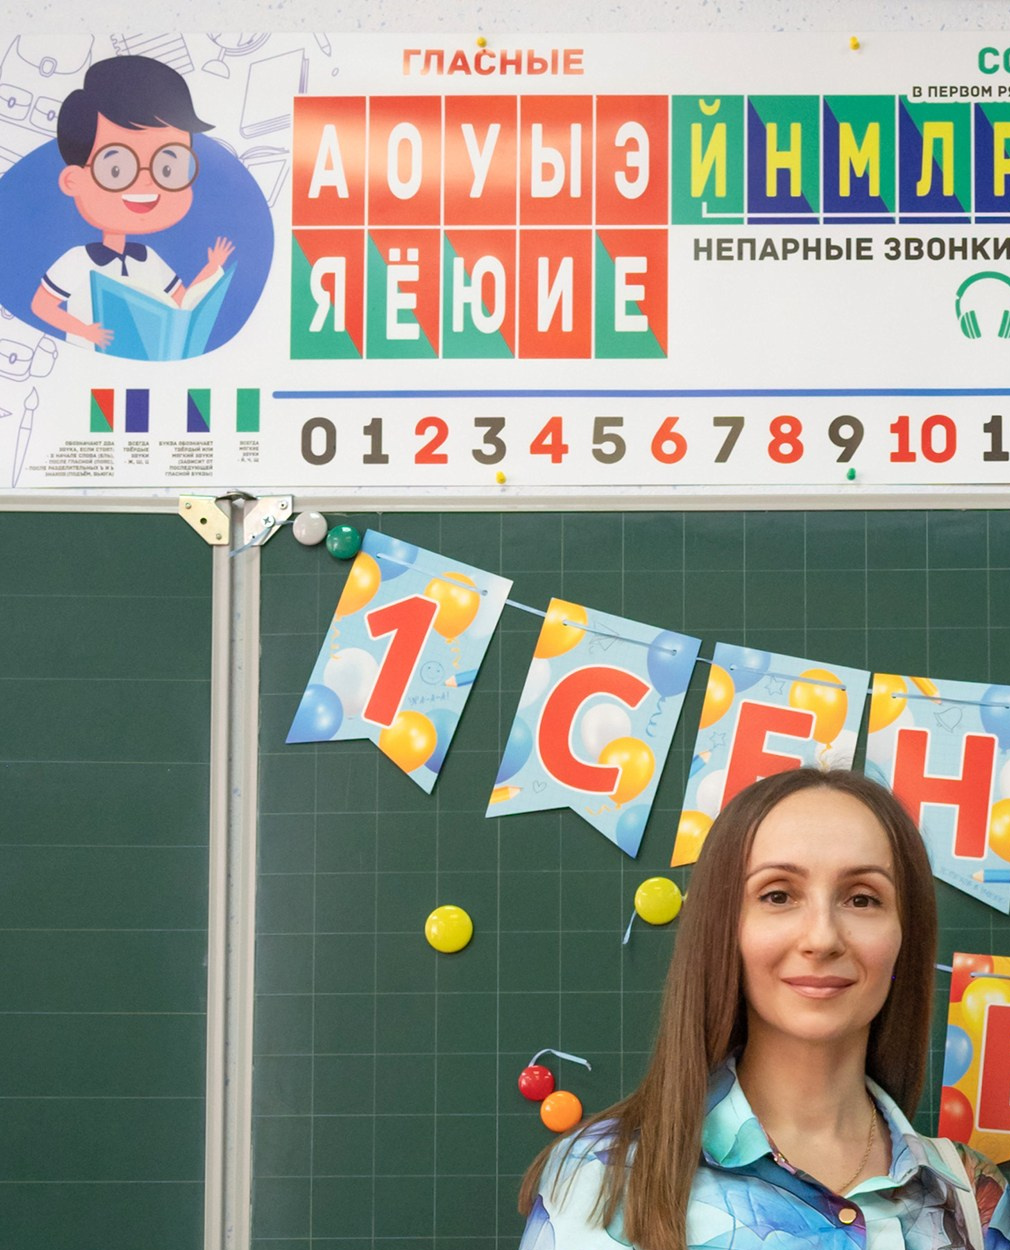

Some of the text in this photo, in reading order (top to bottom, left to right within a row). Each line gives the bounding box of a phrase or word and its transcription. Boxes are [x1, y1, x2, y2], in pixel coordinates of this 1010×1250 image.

[403, 49, 584, 76] ГЛАСНЫЕ
[913, 86, 922, 98] В
[928, 86, 992, 98] ПЕРВОМ
[309, 122, 649, 199] А О У Ы Э
[692, 99, 726, 197] Й
[767, 123, 801, 196] Н
[839, 123, 880, 196] М
[917, 122, 953, 195] Л
[694, 238, 873, 260] НЕПАРНЫЕ
[310, 249, 648, 340] Я Ё Ю И Е
[301, 417, 336, 465] 0
[363, 418, 389, 464] 1
[415, 416, 449, 464] 2
[472, 417, 506, 465] 3
[530, 416, 569, 464] 4
[592, 417, 626, 464] 5
[650, 416, 687, 464] 6
[713, 416, 745, 463] 7
[768, 415, 804, 464] 8
[828, 415, 864, 463] 9
[890, 414, 957, 463] 10
[364, 594, 440, 727] 1
